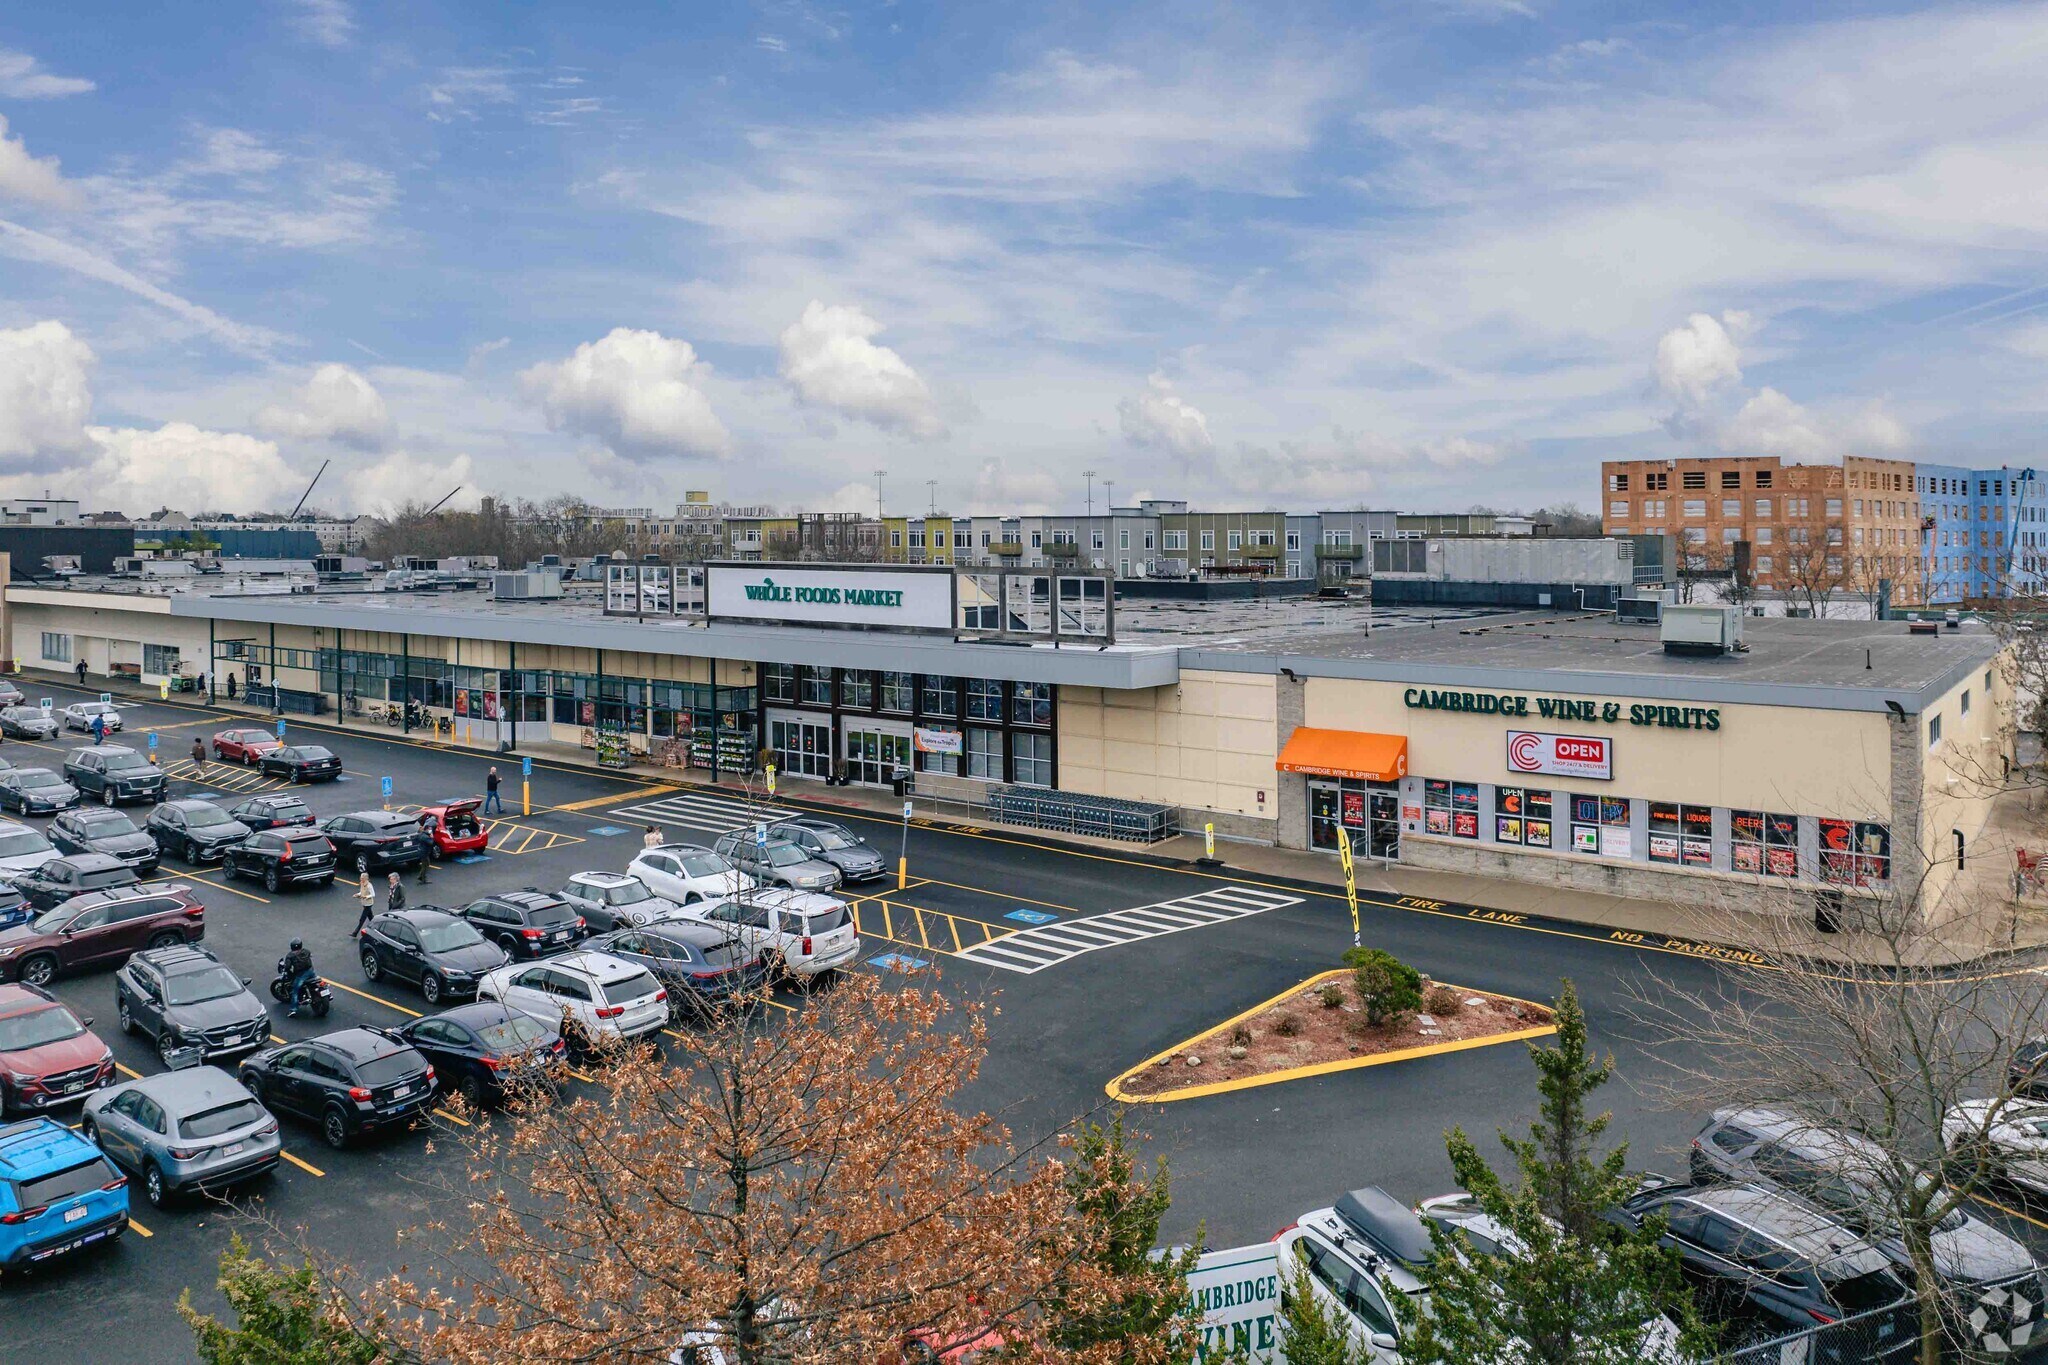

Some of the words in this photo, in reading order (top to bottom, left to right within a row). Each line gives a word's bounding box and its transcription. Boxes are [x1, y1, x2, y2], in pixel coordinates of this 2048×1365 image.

[745, 578, 792, 601] WHOLE
[794, 587, 840, 604] FOODS
[844, 589, 903, 606] MARKET
[1404, 688, 1528, 717] CAMBRIDGE
[1537, 698, 1596, 722] WINE
[1602, 702, 1620, 723] &
[1629, 704, 1720, 731] SPIRITS
[1558, 743, 1600, 758] OPEN
[1294, 765, 1331, 775] CAMBRIDGE
[1332, 769, 1348, 777] WINE
[1355, 772, 1380, 780] SPIRITS
[1502, 788, 1523, 797] OPEN
[1736, 817, 1764, 828] BEERS
[1395, 896, 1447, 911] FIRE
[1467, 908, 1529, 925] LANE
[1610, 930, 1645, 944] NO
[1663, 939, 1766, 965] PARKING
